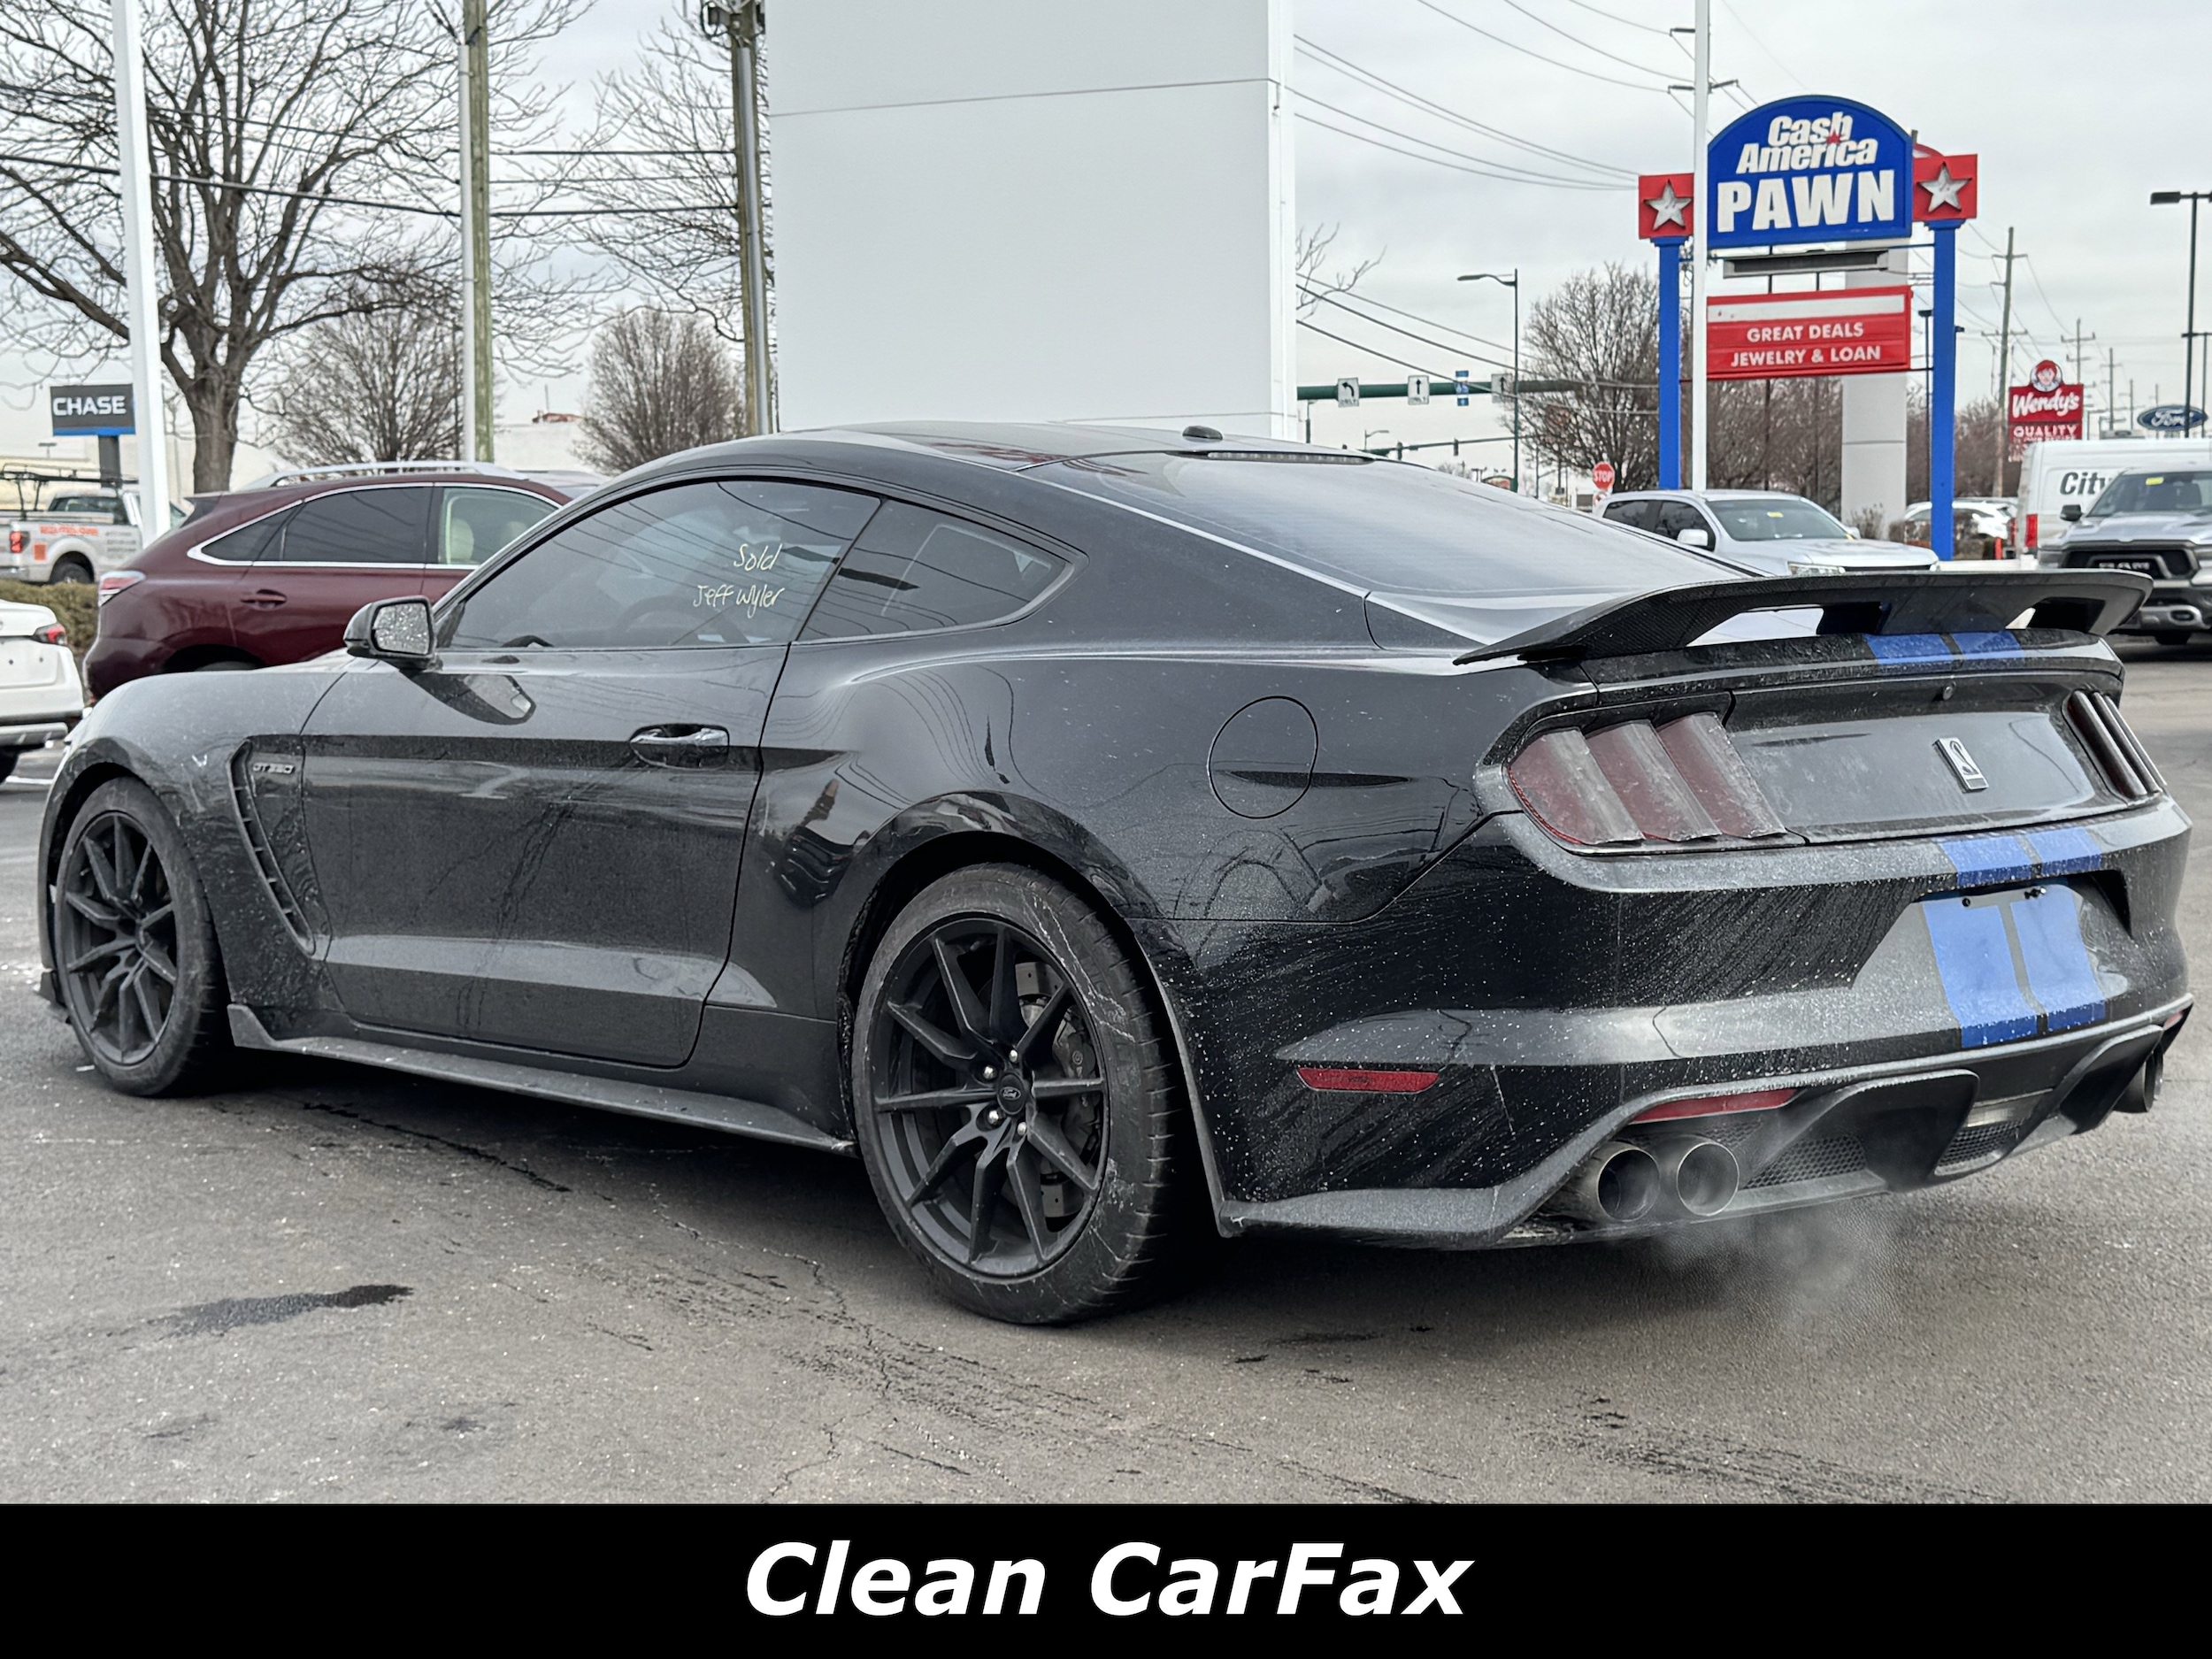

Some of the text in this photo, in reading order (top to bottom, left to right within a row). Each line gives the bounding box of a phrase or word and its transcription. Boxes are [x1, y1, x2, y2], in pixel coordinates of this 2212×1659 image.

[1768, 111, 1853, 146] Cash
[1736, 138, 1878, 174] America
[1717, 169, 1894, 233] PAWN
[1747, 322, 1864, 342] GREAT DEALS
[1731, 346, 1880, 367] JEWELRY & LOAN
[53, 396, 127, 416] CHASE
[2012, 388, 2079, 418] Wendy's
[2013, 425, 2078, 437] QUALITY
[1594, 470, 1614, 482] STOP
[733, 543, 783, 571] Sold
[693, 584, 734, 607] Jeff
